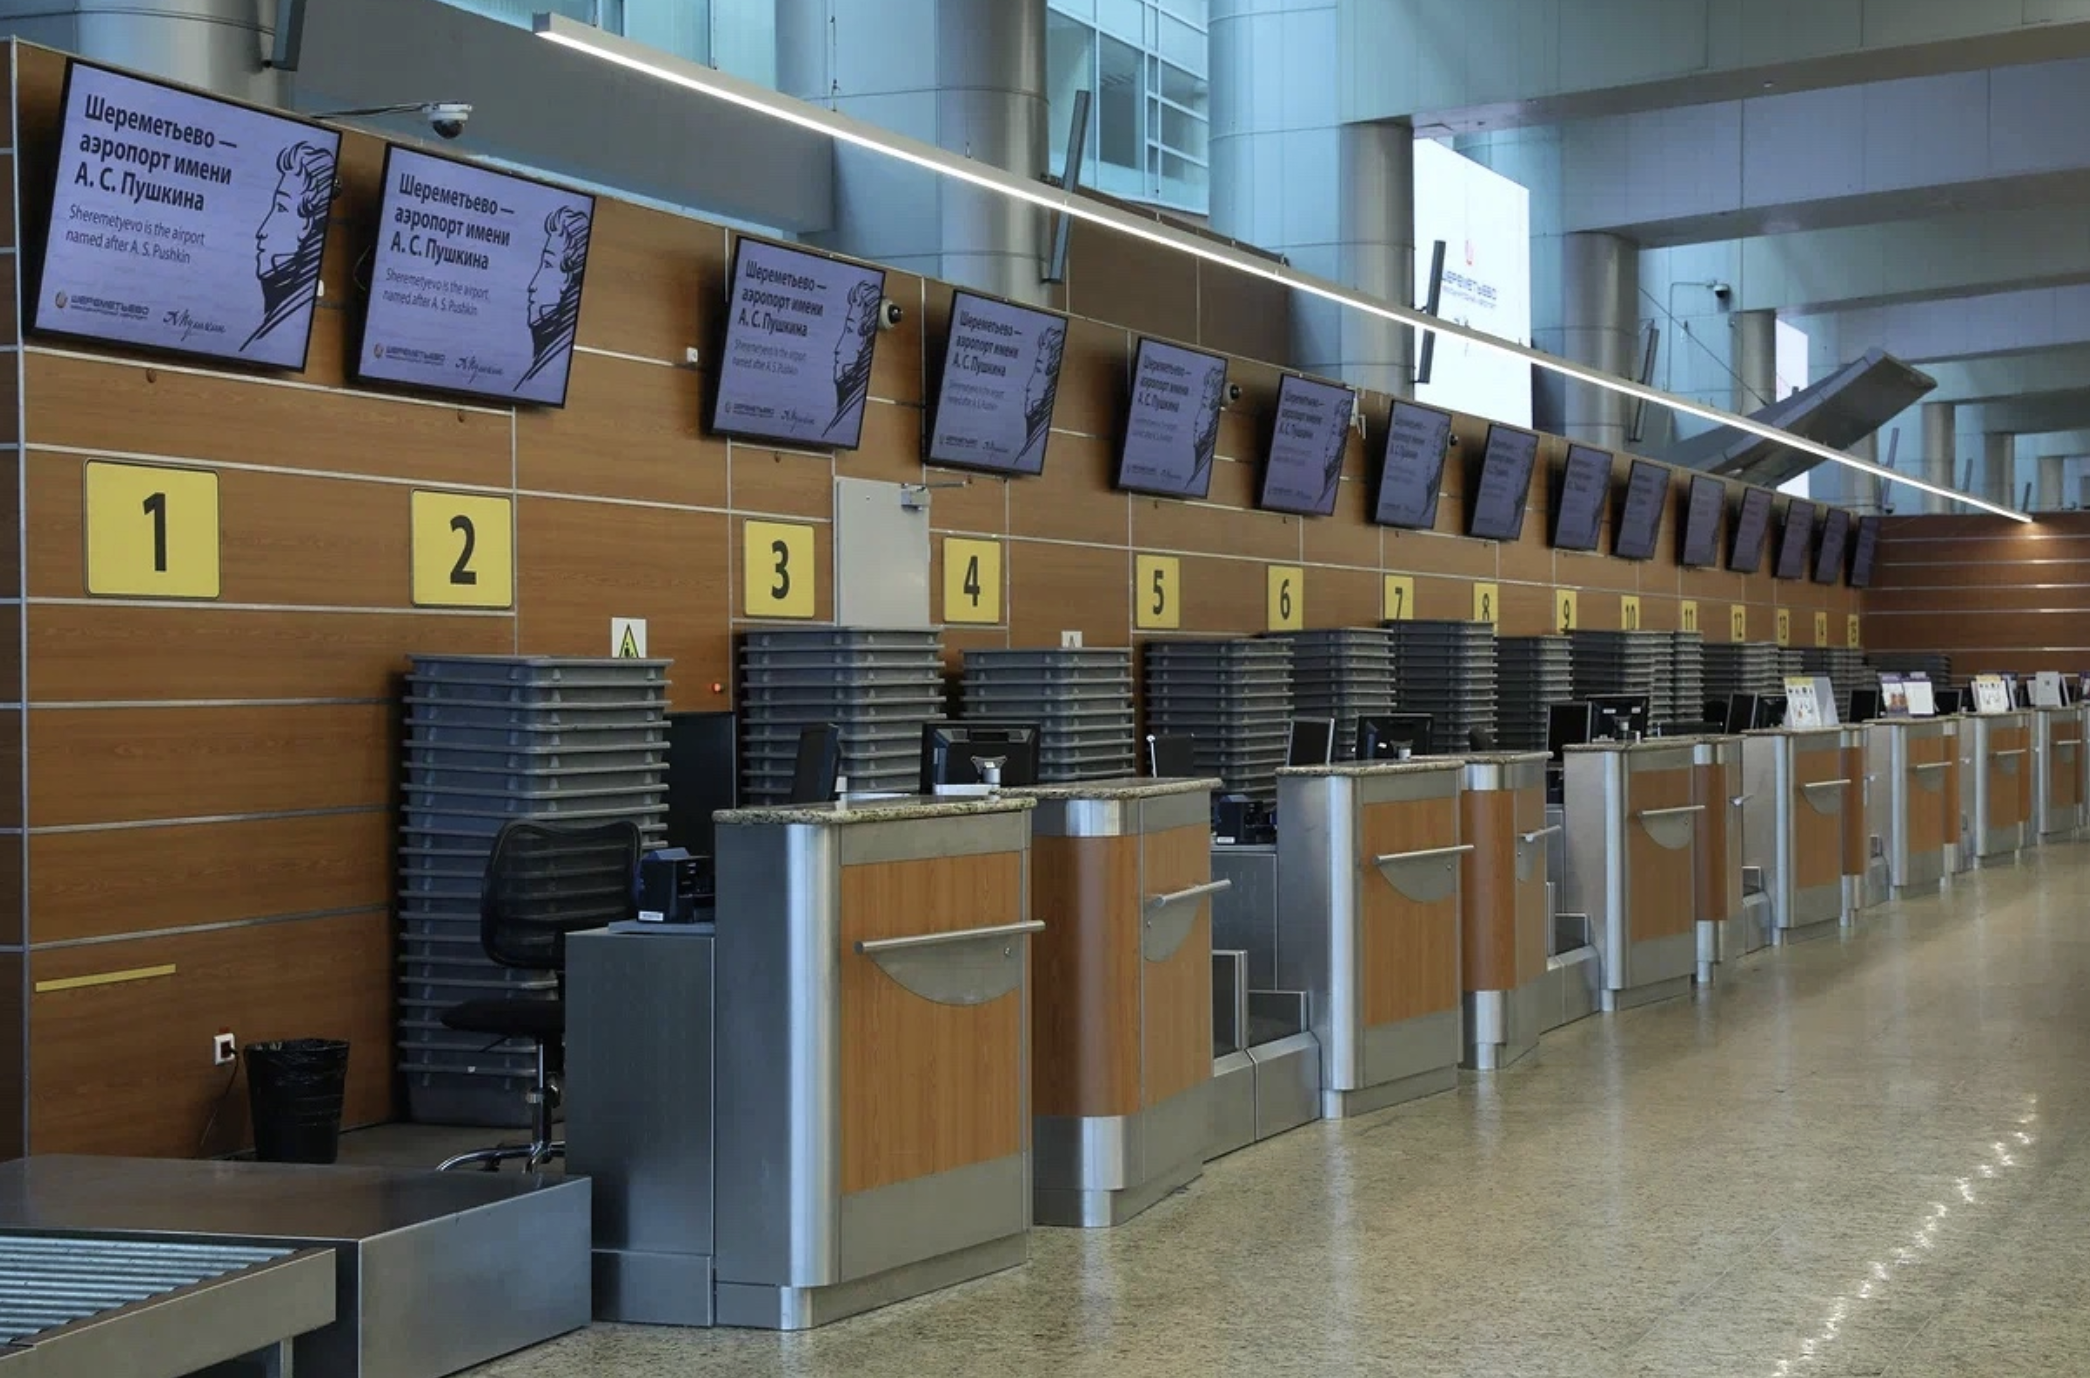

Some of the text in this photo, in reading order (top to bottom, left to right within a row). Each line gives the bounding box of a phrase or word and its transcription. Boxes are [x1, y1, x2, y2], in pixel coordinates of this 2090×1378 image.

[84, 94, 215, 149] Шереметьево
[80, 134, 232, 185] аэропорт имени
[74, 161, 205, 211] А. С. Пушкина
[398, 172, 499, 216] Шереметьево
[65, 228, 102, 248] named
[103, 233, 128, 252] after
[152, 246, 191, 264] Pushkin
[69, 203, 206, 247] Sheremetyevo is the airport
[394, 206, 511, 247] аэропорт имени
[390, 231, 490, 271] А. С. Пушкина
[745, 259, 815, 292] Шереметьево
[741, 287, 824, 317] аэропорт имени
[762, 312, 808, 338] Пушкина
[142, 492, 167, 572] 1
[450, 514, 477, 585] 2
[771, 540, 790, 600] 3
[963, 554, 981, 607] 4
[1152, 569, 1164, 615] 5
[1280, 578, 1291, 621] 6
[1394, 586, 1404, 621] 7
[1481, 592, 1491, 621] 8
[1563, 599, 1570, 631] 9
[1625, 603, 1636, 630] 10
[1684, 608, 1694, 631] 11
